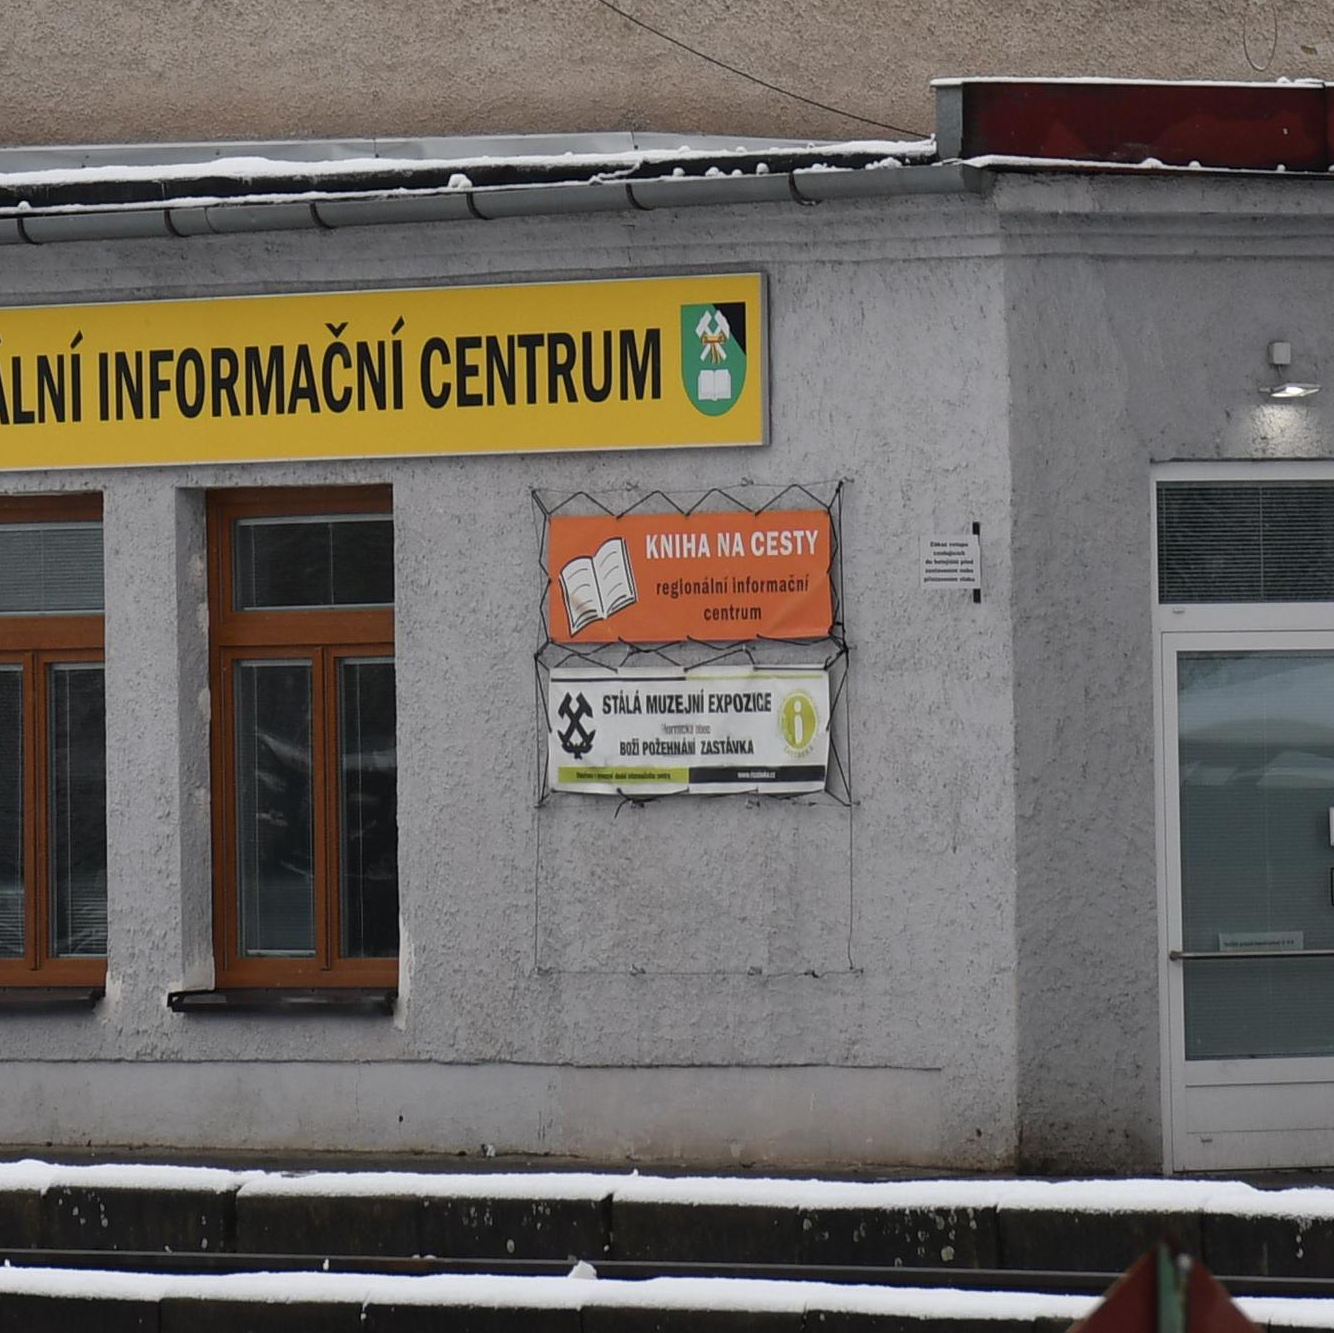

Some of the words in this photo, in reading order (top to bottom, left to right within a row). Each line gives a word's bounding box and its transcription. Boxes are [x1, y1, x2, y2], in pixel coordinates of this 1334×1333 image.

[98, 315, 406, 423] INFORMAČNÍ
[420, 327, 662, 410] CENTRUM
[645, 533, 711, 559] KNIHA
[717, 531, 746, 558] NA
[750, 529, 819, 558] CESTY
[656, 576, 728, 599] regionální
[732, 573, 810, 594] informační
[703, 604, 762, 621] centrum
[602, 689, 641, 715] STÁLÁ
[645, 688, 705, 715] MUZEJNÍ
[708, 692, 772, 714] EXPOZICE
[619, 738, 640, 756] BOŽÍ
[642, 737, 696, 756] POŽEHNÁNÍ
[700, 736, 755, 756] ZASTÁVKA
